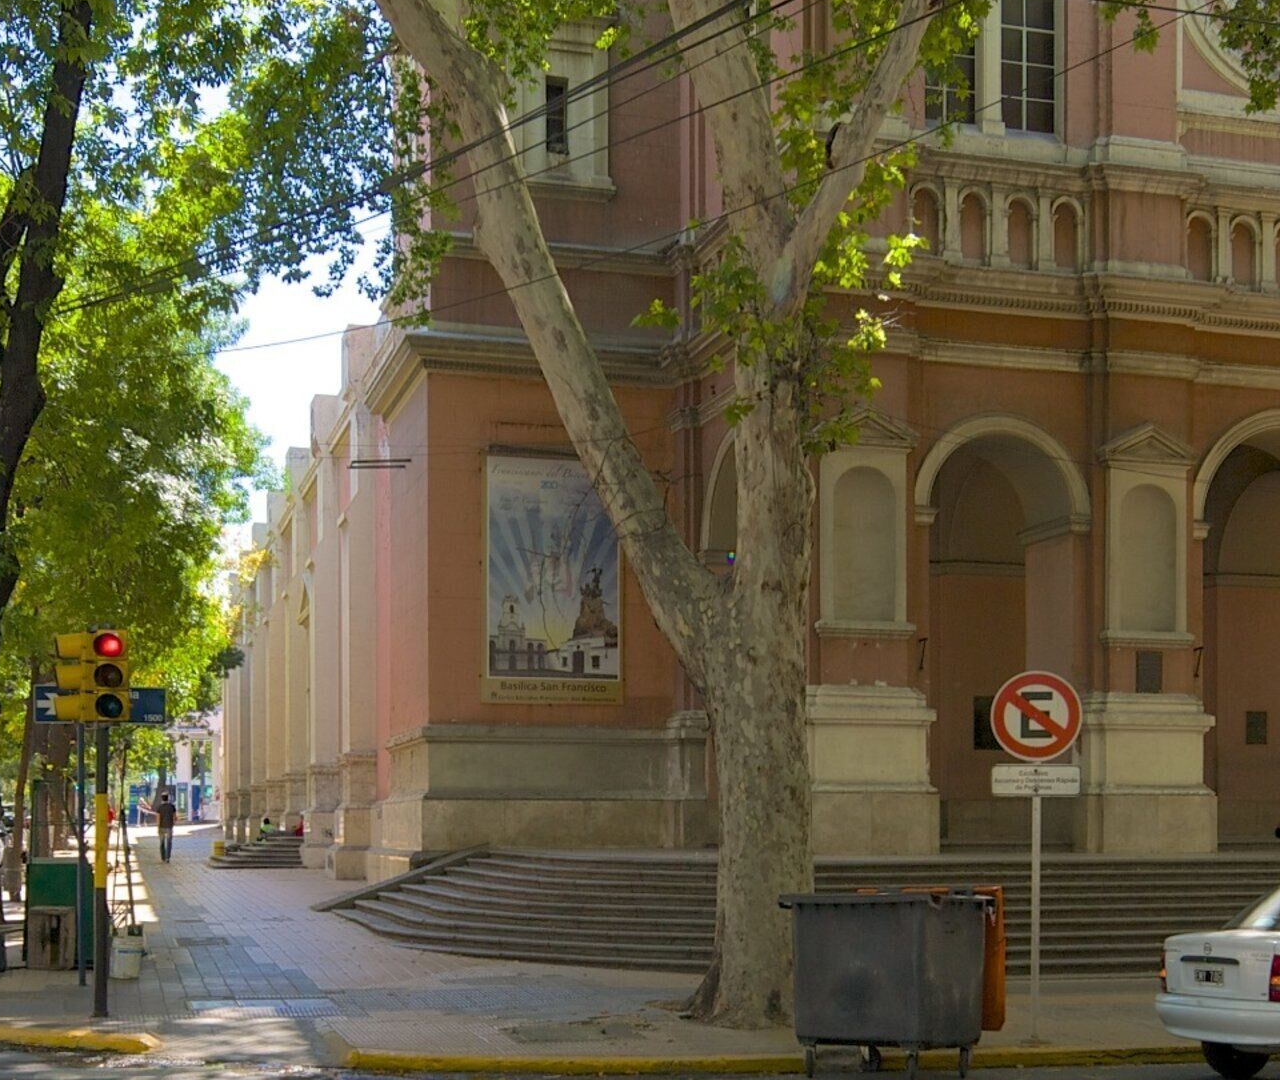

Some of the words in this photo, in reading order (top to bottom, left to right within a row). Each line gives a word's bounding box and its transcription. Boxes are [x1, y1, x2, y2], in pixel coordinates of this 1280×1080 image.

[540, 682, 559, 691] San
[561, 683, 607, 693] Francisco
[144, 714, 163, 722] 1500
[1021, 692, 1053, 738] E
